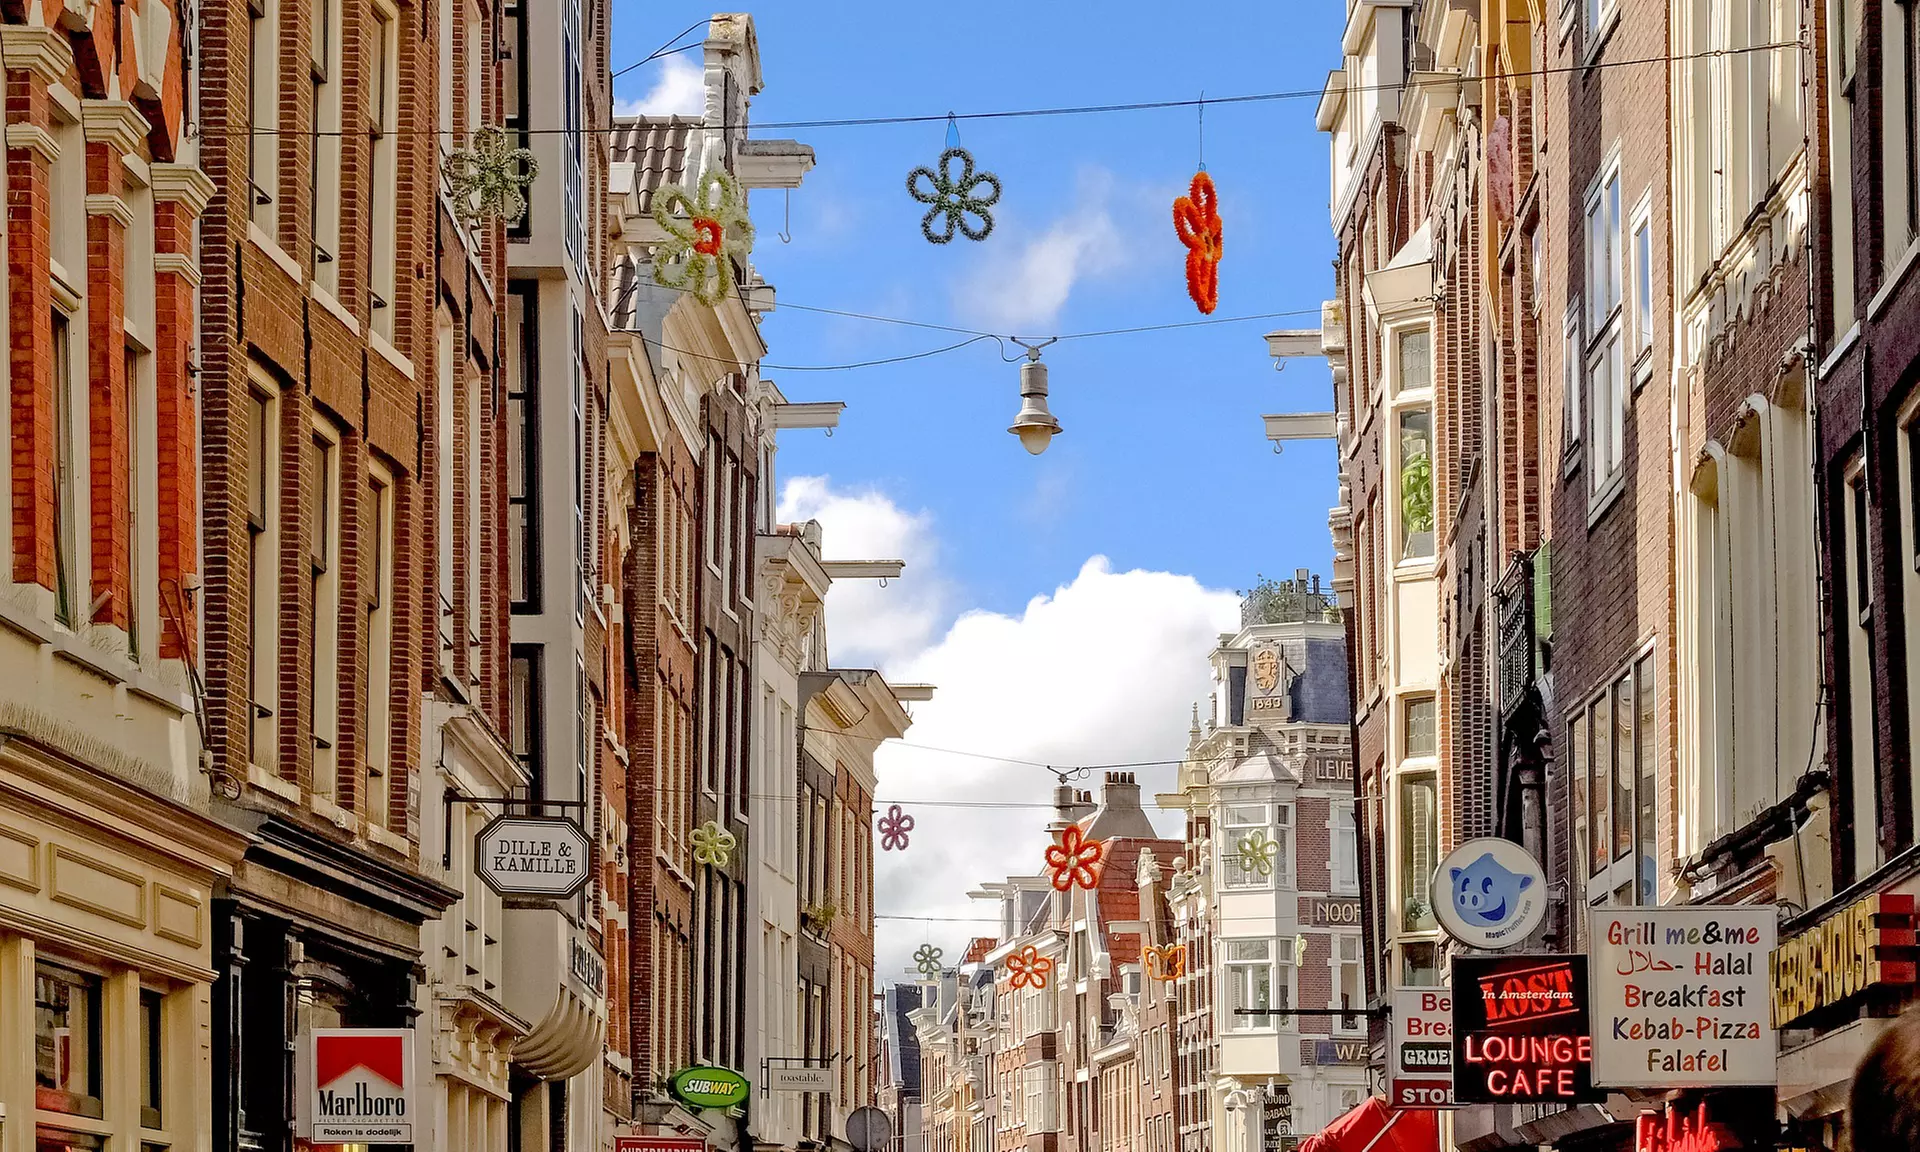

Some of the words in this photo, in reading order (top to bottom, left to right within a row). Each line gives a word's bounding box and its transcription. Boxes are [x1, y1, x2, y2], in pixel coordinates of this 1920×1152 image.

[1316, 759, 1354, 780] LEVE
[499, 840, 551, 856] DILLE
[558, 842, 572, 857] &
[493, 856, 576, 874] KAMILLE
[1607, 920, 1656, 945] Grill
[1666, 920, 1760, 945] me&me
[1694, 952, 1752, 976] Halal
[1480, 969, 1573, 1020] LOST
[1482, 990, 1496, 999] In
[1498, 989, 1574, 999] Amsterdam
[1624, 984, 1746, 1008] Breakfast
[1613, 1016, 1760, 1040] Kebab-Pizza
[1465, 1035, 1592, 1063] LOUNGE
[1647, 1048, 1728, 1072] Falafel
[684, 1079, 741, 1095] SUBWAY
[1487, 1069, 1575, 1095] CAFE
[318, 1082, 405, 1116] Marlboro
[323, 1128, 353, 1136] Roken
[366, 1128, 402, 1137] dodelijk
